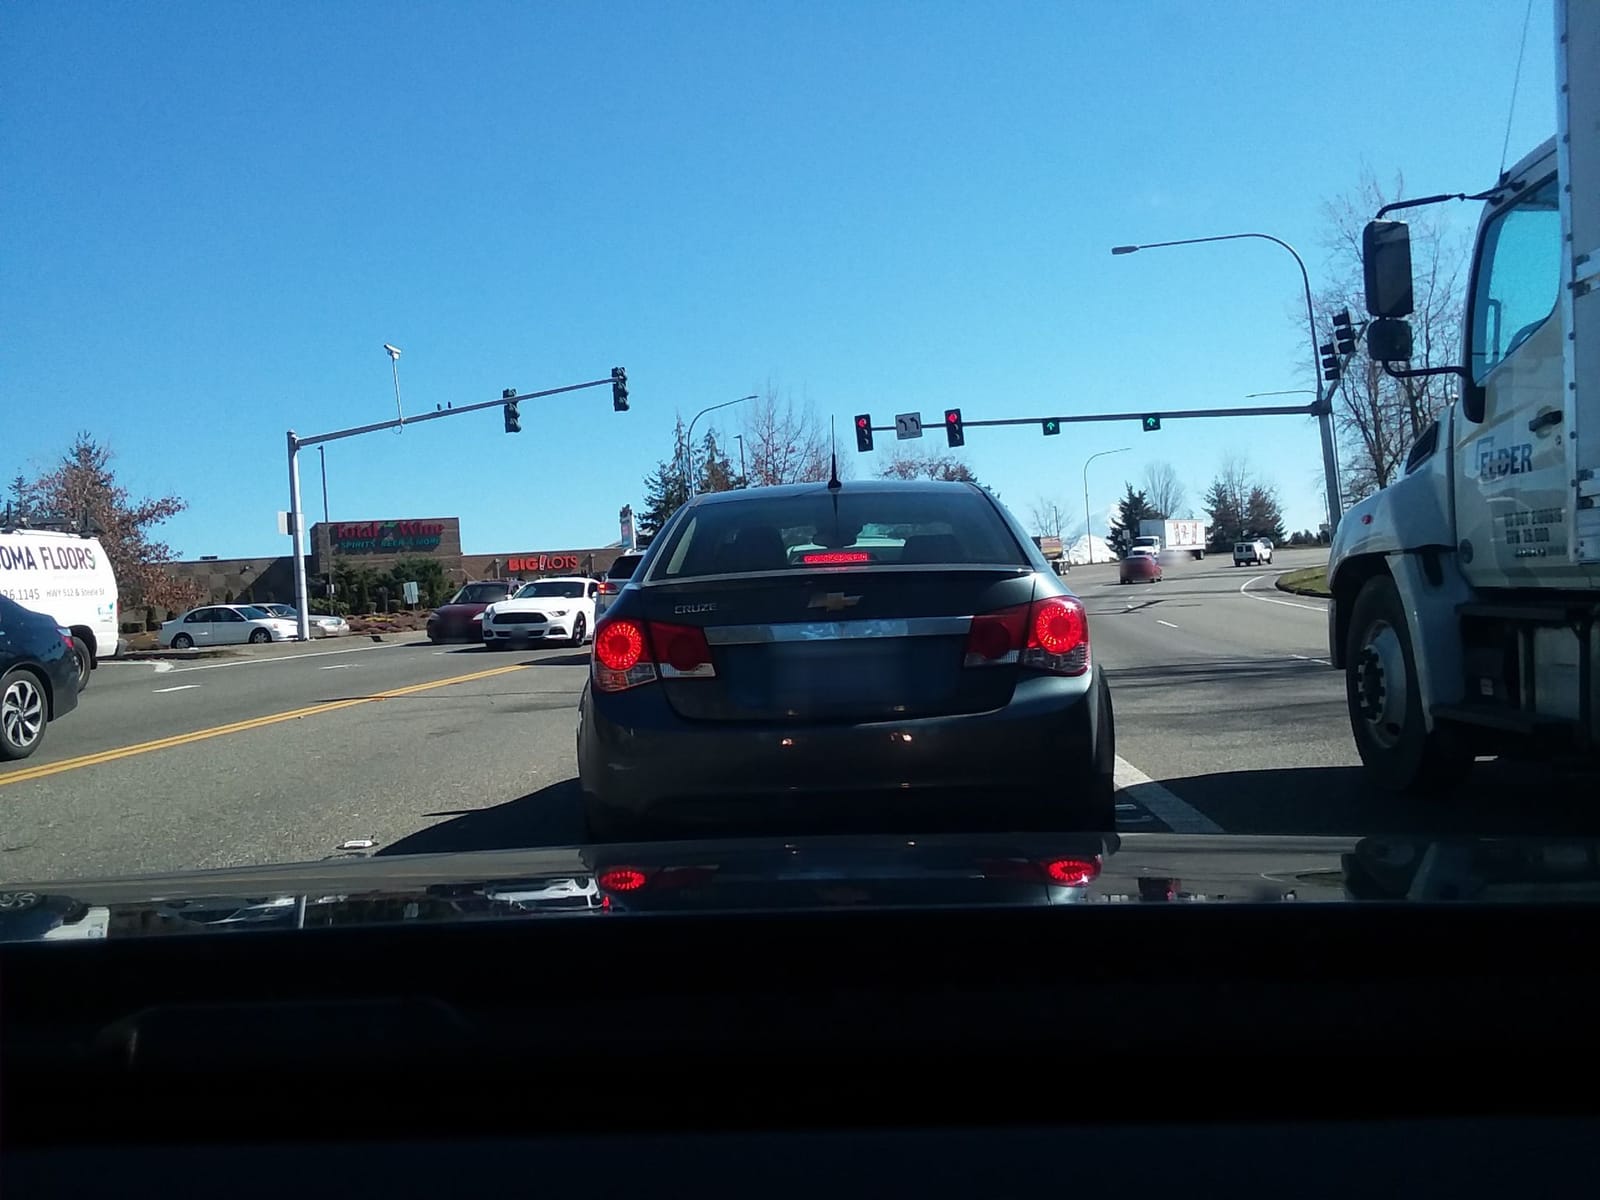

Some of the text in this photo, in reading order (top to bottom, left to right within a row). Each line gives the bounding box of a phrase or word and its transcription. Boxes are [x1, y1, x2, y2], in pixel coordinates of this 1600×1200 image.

[334, 519, 445, 539] Total Wine
[340, 539, 376, 549] SPIRITS
[0, 545, 96, 571] OMA FLOORS
[0, 588, 40, 600] 26.1145
[63, 588, 74, 597] 512
[674, 603, 717, 614] CRUZE
